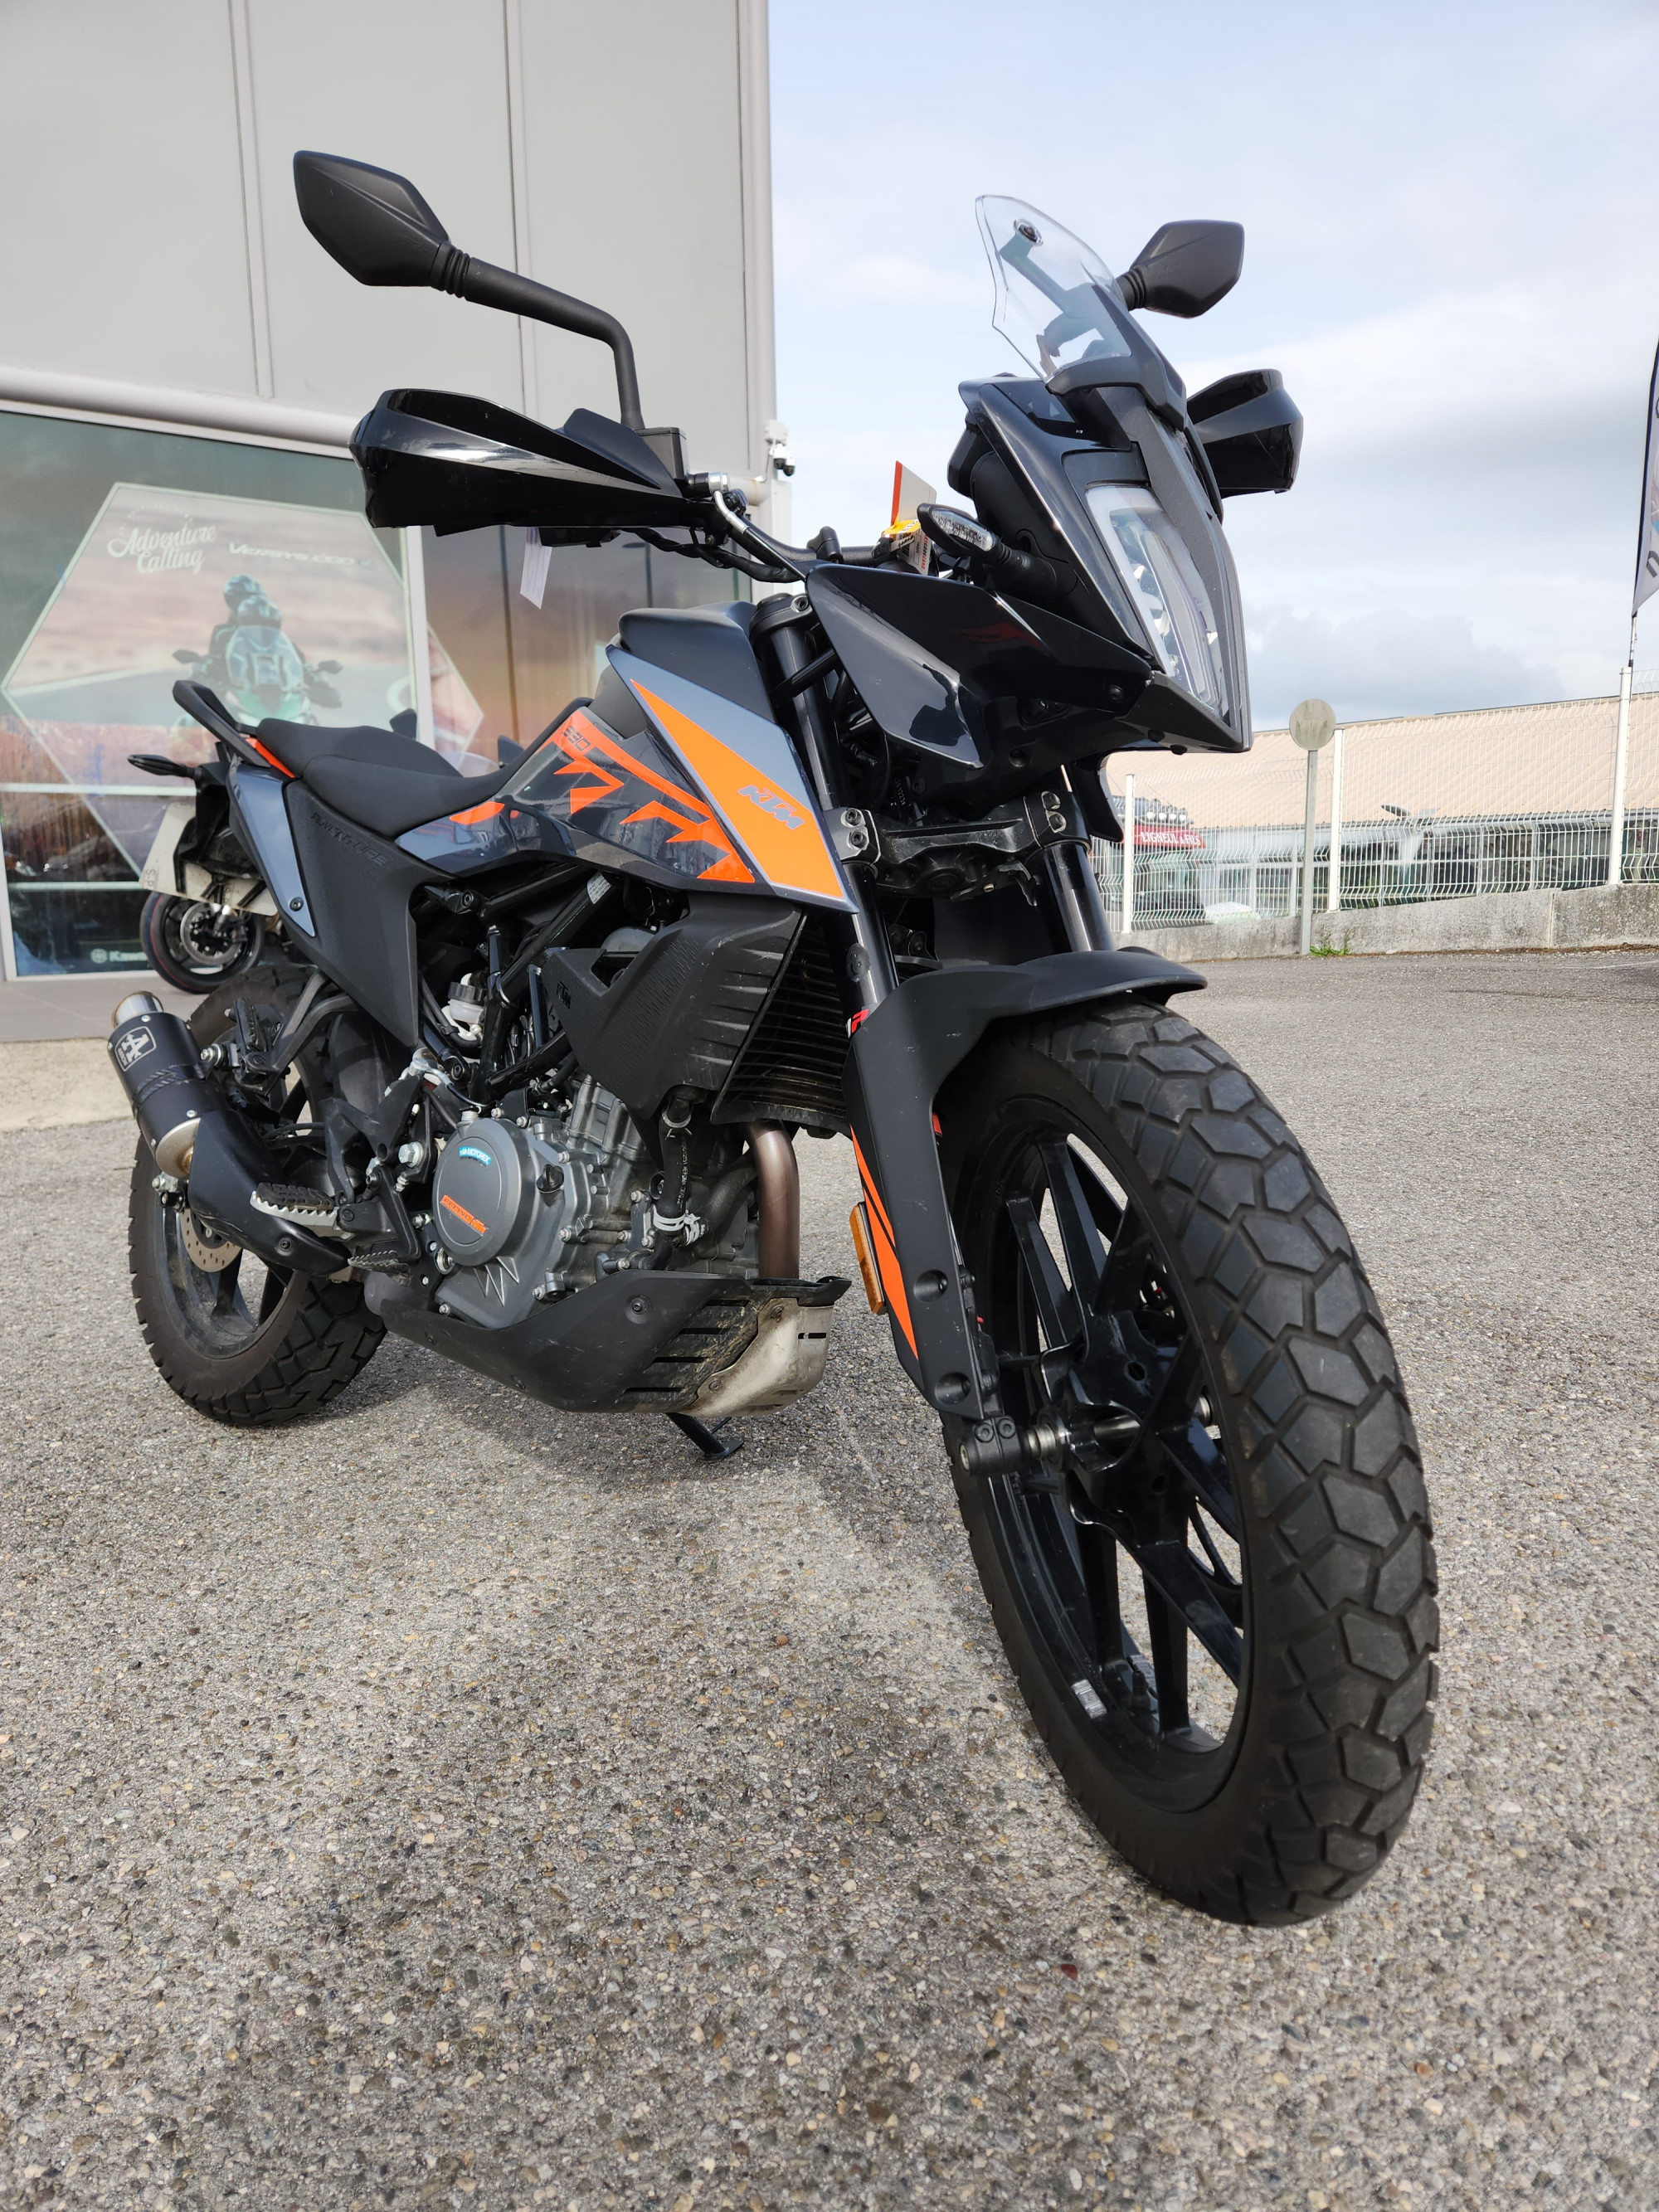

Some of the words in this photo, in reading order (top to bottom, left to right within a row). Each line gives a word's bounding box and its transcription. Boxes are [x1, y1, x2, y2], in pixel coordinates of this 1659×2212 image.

[107, 524, 217, 557] Adventure
[137, 547, 206, 574] Calling
[562, 725, 591, 751] 390
[737, 784, 805, 830] KTM
[109, 950, 148, 962] Kawa
[467, 1148, 490, 1165] MOTOREX
